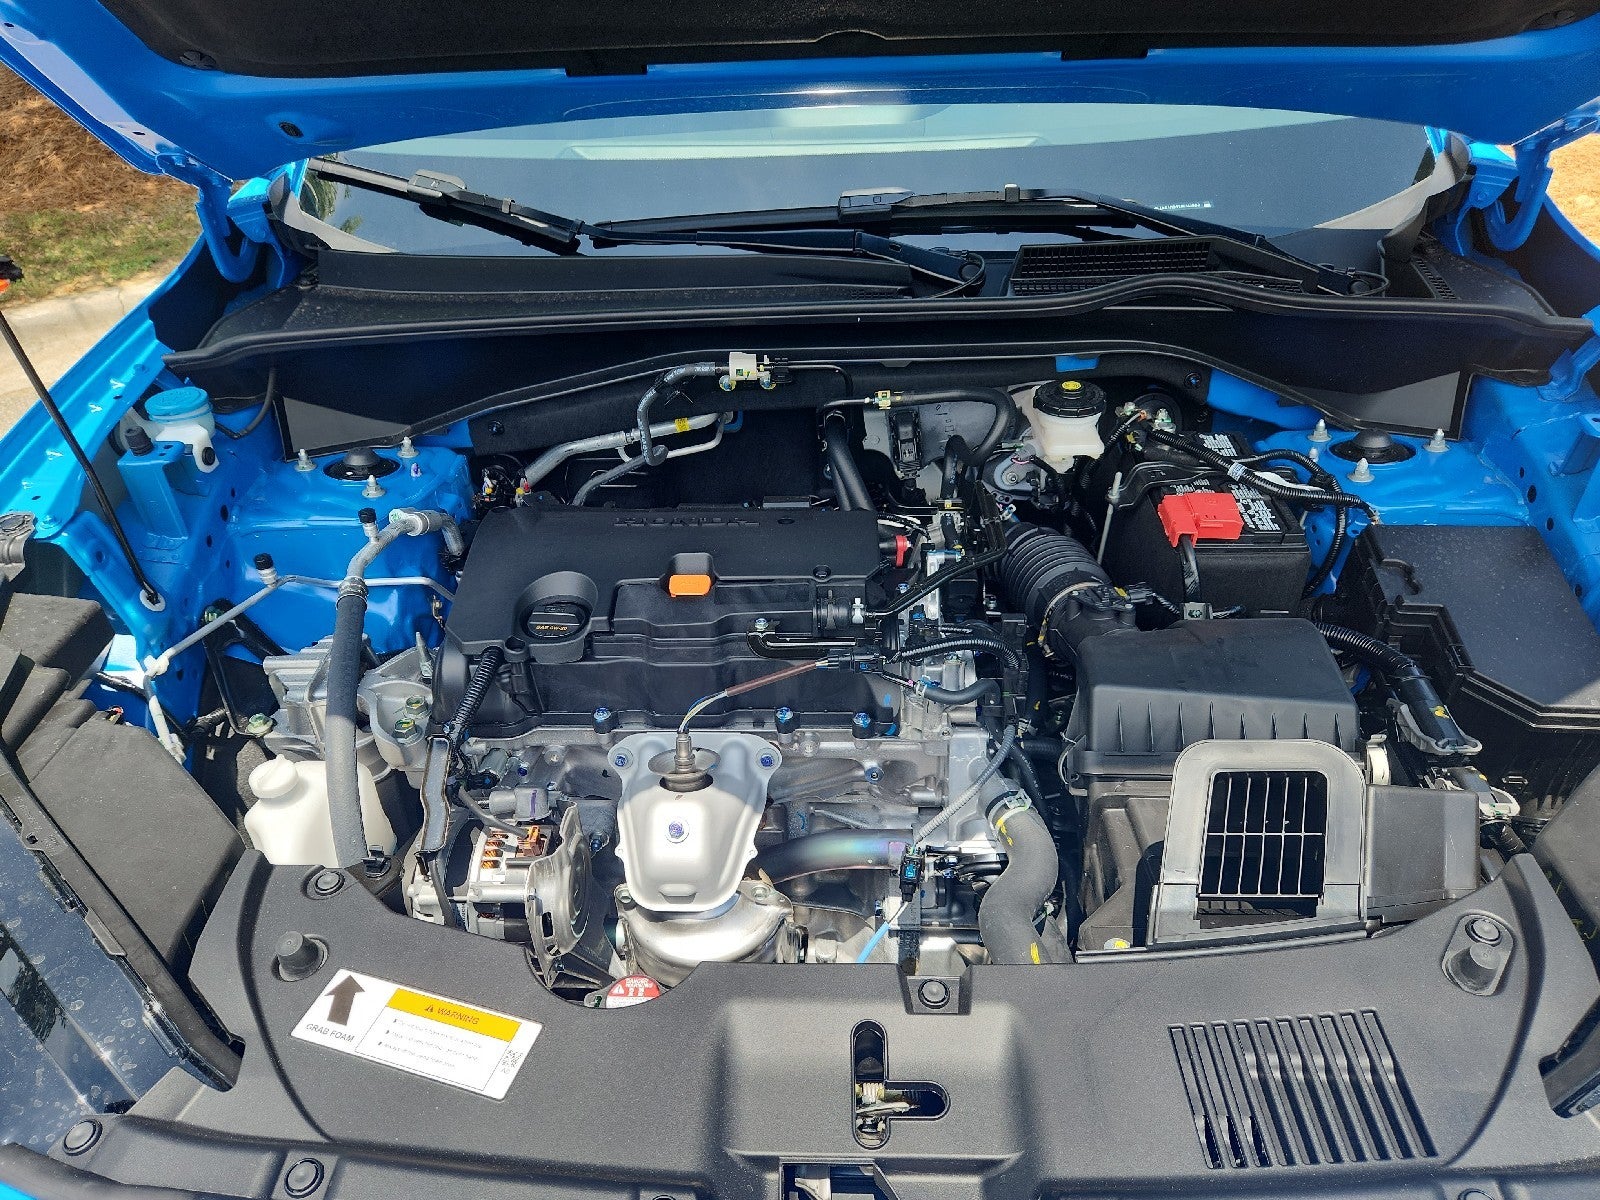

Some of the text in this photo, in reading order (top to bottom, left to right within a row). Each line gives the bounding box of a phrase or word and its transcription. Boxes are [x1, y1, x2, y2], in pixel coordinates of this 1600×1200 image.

[613, 517, 760, 527] HONDA
[437, 1007, 480, 1026] WARNING
[305, 1023, 355, 1044] GRAB FOAM
